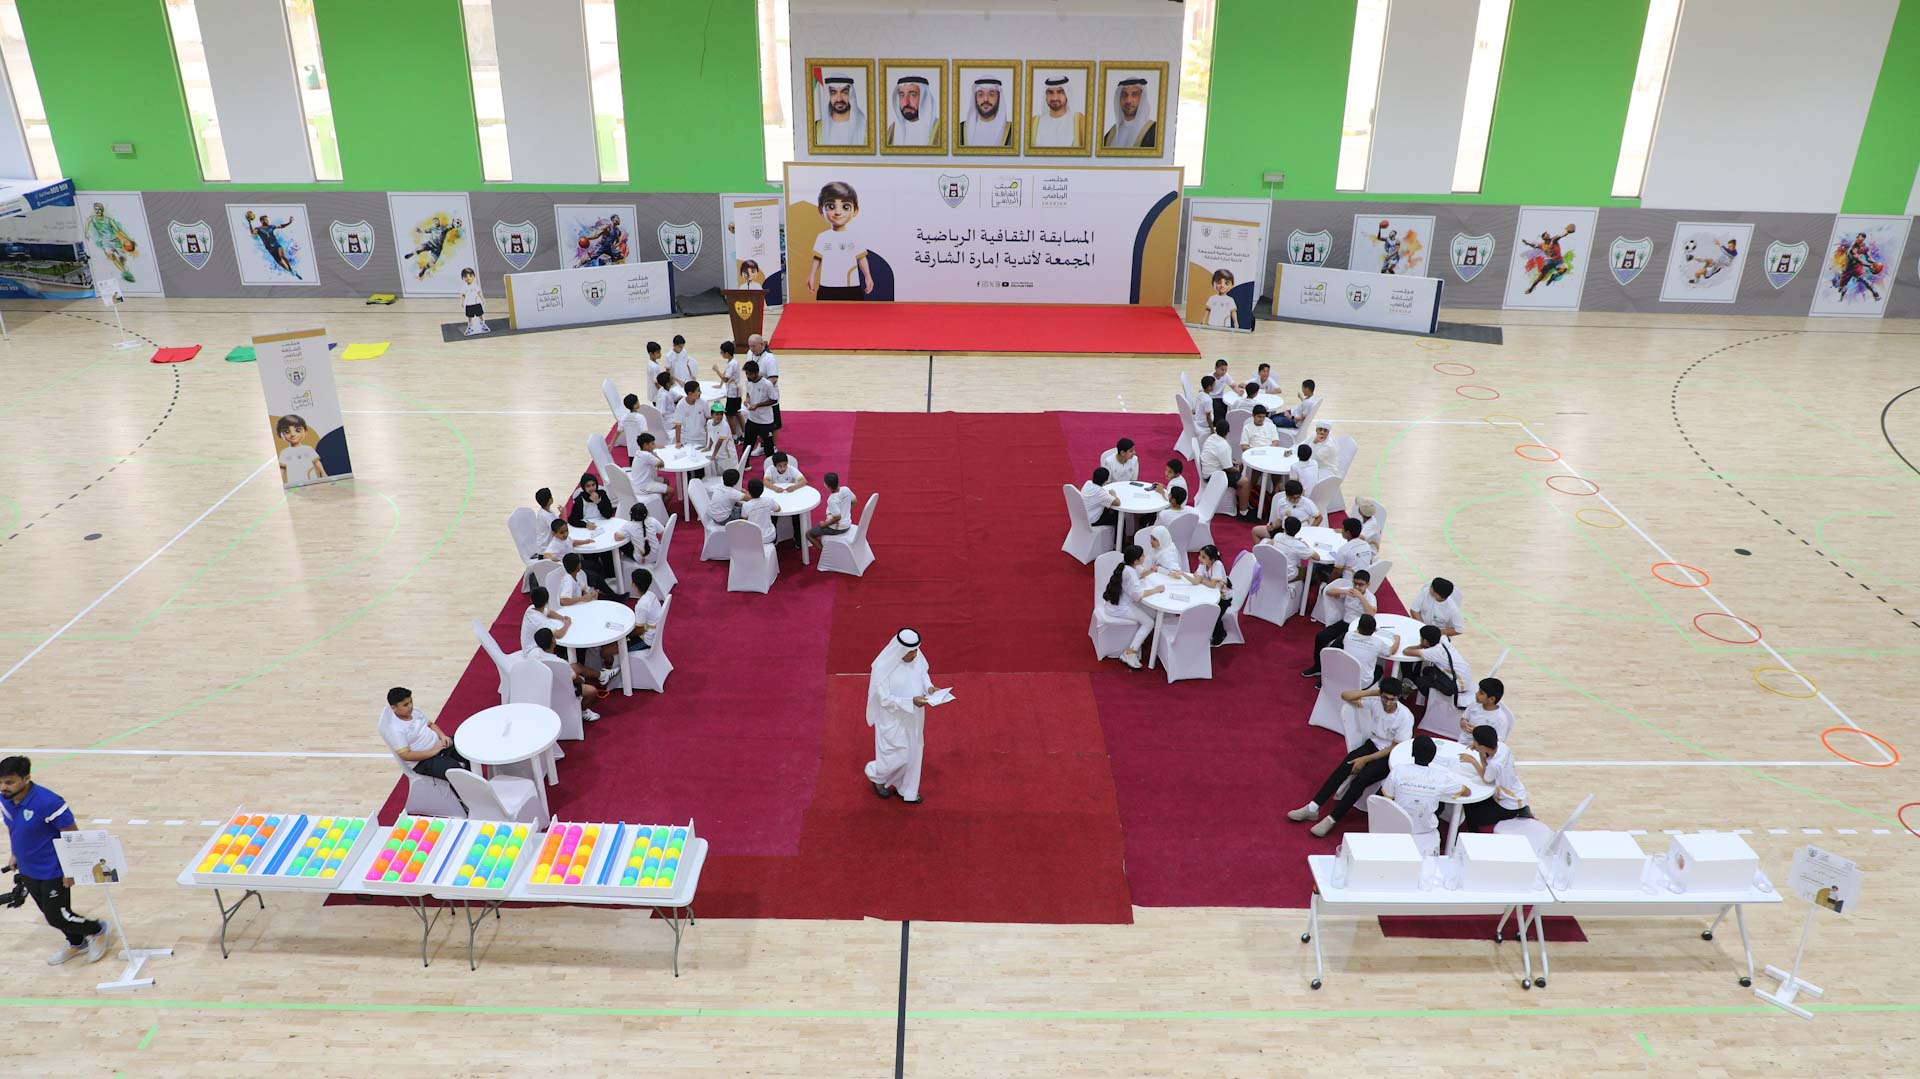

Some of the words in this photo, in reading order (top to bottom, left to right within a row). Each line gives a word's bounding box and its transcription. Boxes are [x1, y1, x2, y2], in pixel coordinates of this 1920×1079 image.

[916, 228, 976, 247] الرياضية
[980, 229, 1035, 245] الثقافية
[1039, 229, 1095, 246] المسابقة
[914, 251, 964, 268] الشارقة
[969, 252, 999, 269] إمارة
[1004, 250, 1041, 268] لأندية
[1045, 252, 1095, 268] المجمعة
